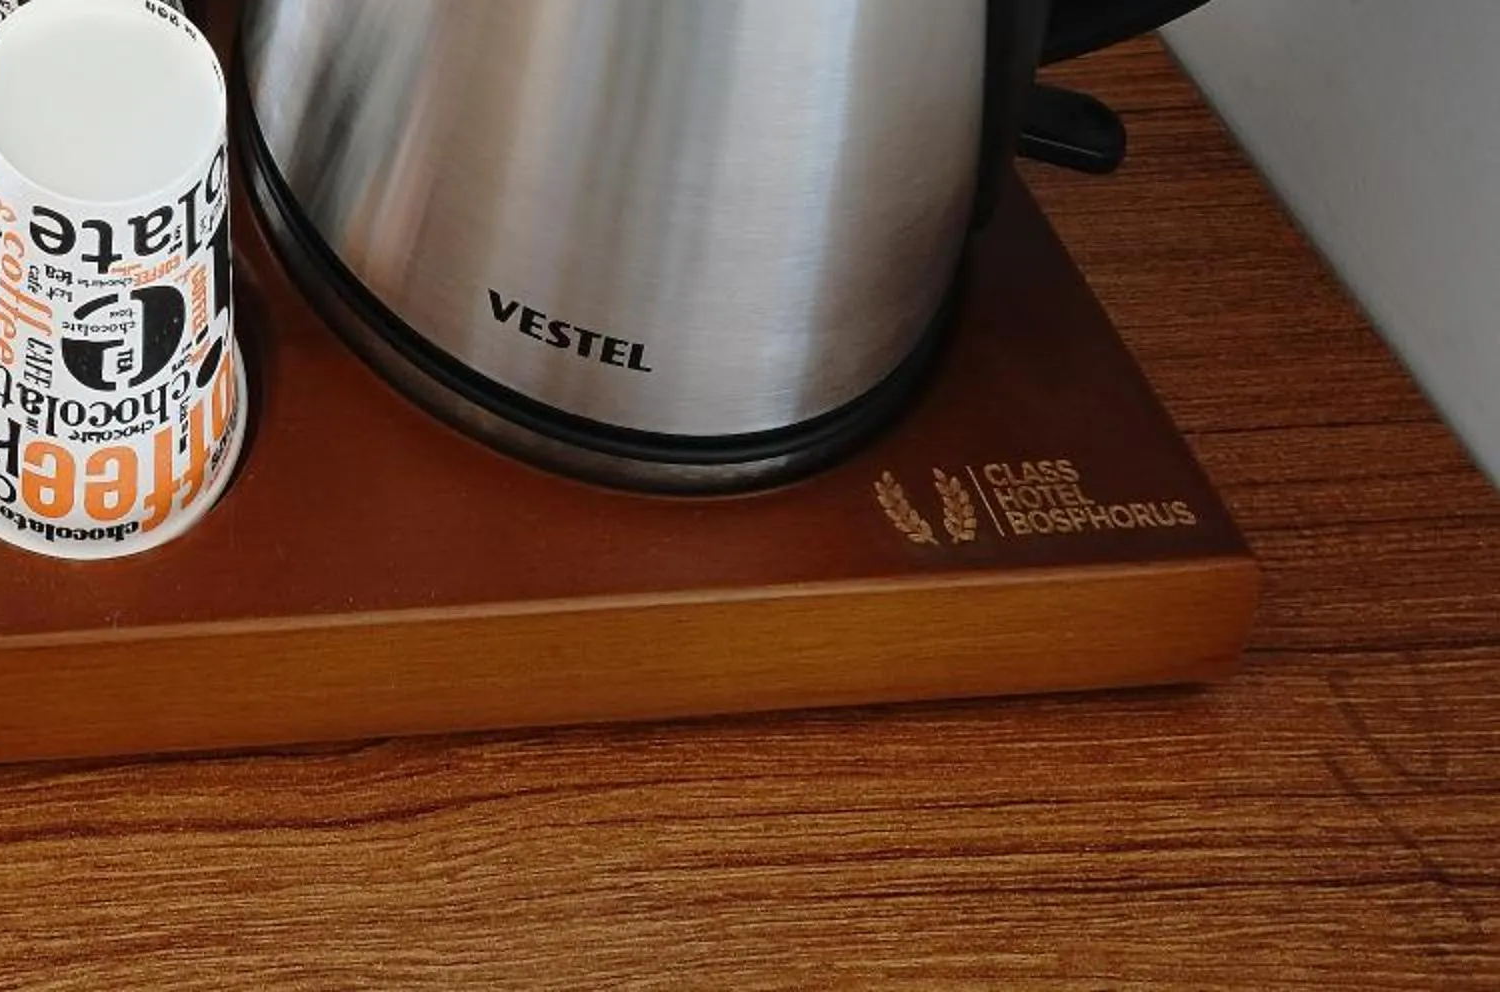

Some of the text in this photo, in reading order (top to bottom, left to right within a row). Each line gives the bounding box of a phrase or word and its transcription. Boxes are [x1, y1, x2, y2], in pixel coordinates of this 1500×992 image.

[487, 287, 653, 373] VESTEL
[983, 459, 1080, 487] CLASS
[993, 483, 1096, 510] HOTEL
[1005, 500, 1198, 536] BOSPHORUS
